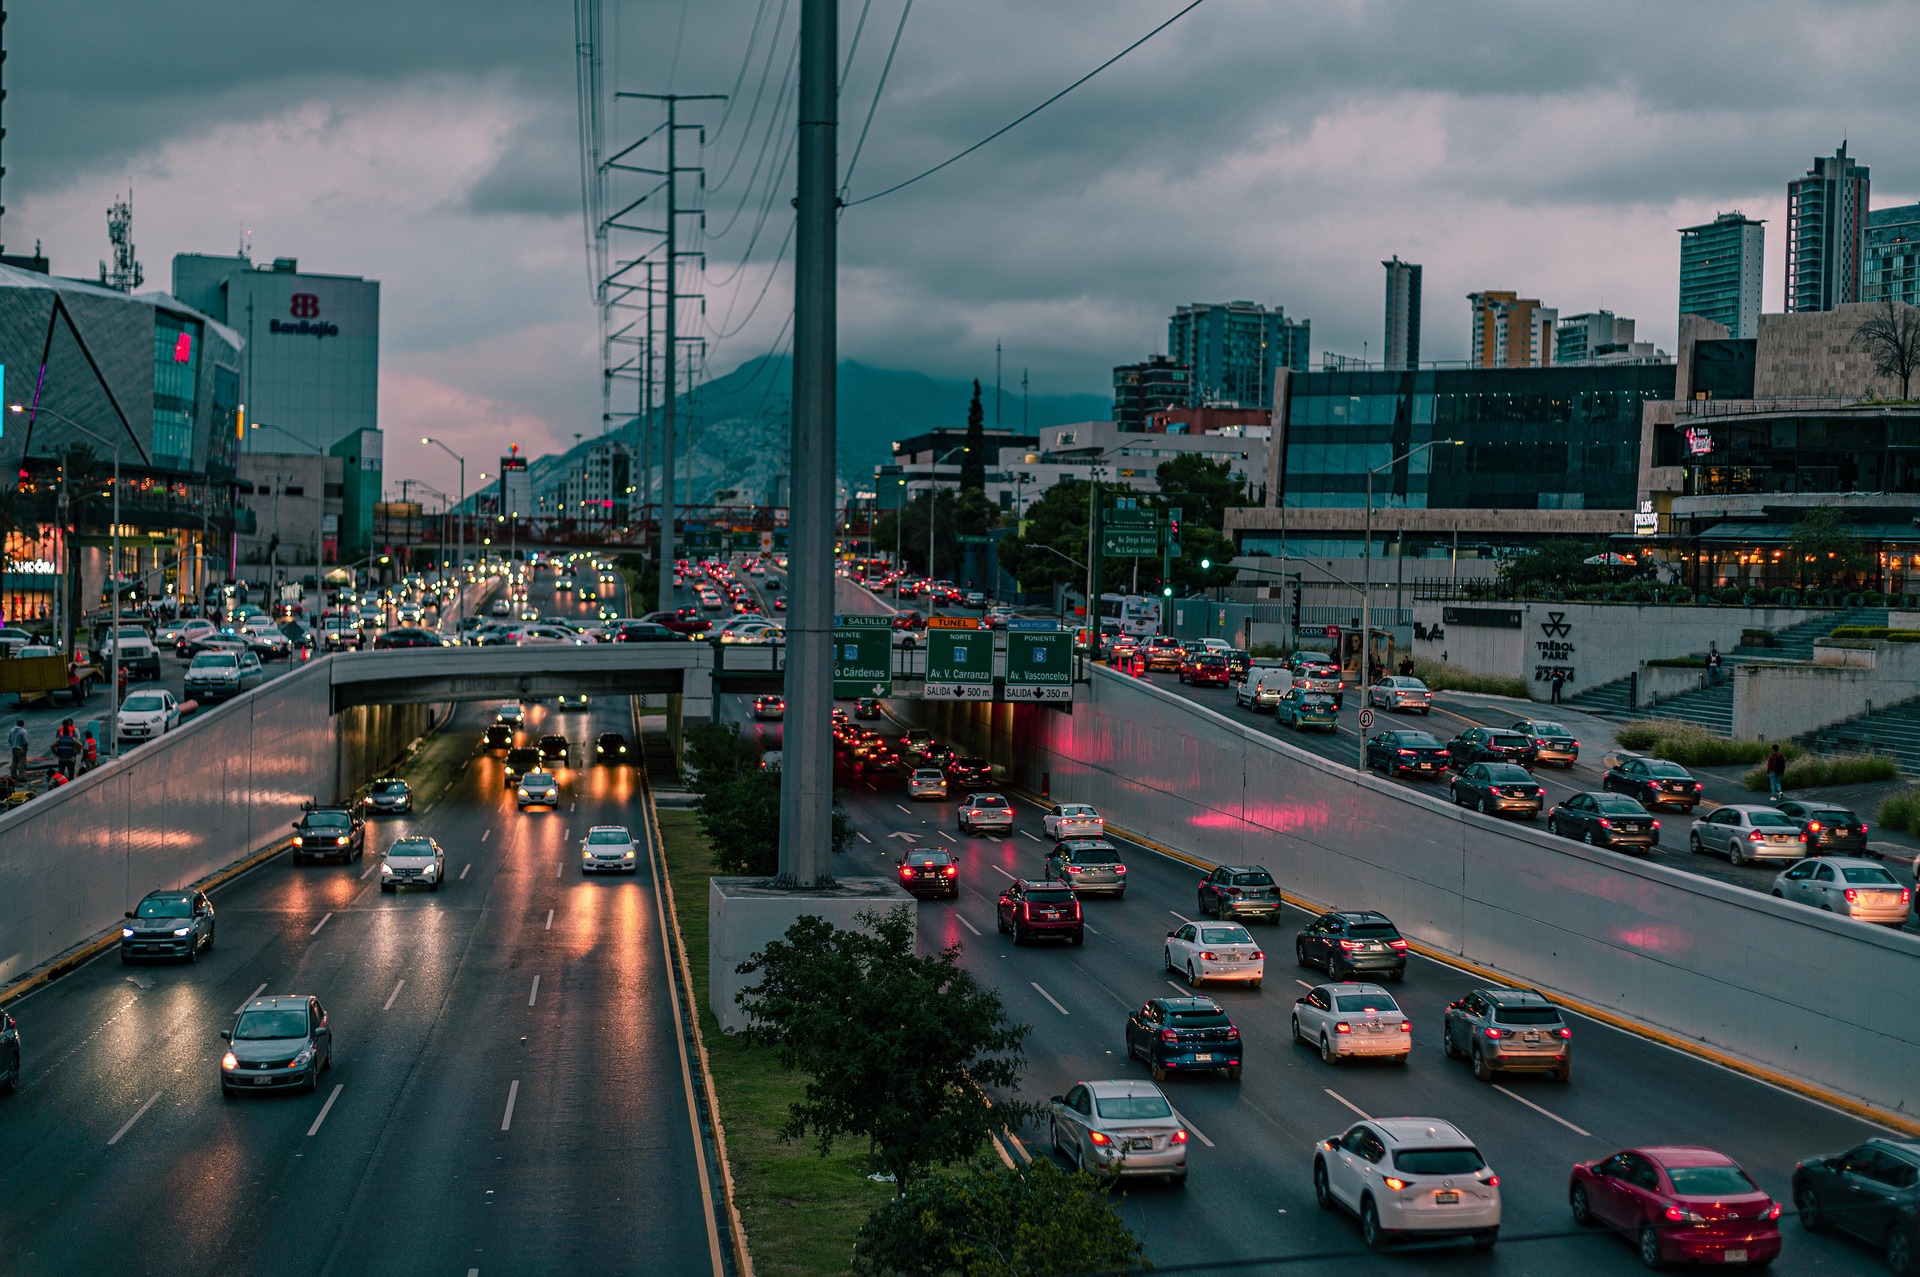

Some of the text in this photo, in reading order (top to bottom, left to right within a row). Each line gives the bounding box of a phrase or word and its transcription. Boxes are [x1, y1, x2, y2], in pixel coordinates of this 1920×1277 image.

[1641, 500, 1652, 513] LOS
[1125, 536, 1139, 545] Diego
[1140, 536, 1156, 544] Rivera
[848, 617, 888, 625] SALTILLO
[938, 619, 969, 627] TUNEL
[955, 652, 965, 661] 11
[1036, 651, 1043, 661] 8
[1542, 651, 1568, 660] PARK
[843, 666, 885, 678] Cárdenas
[930, 668, 989, 679] Av. V. Carranza
[1009, 670, 1069, 681] Av. Vasconcelos
[927, 687, 951, 696] SALIDA
[967, 688, 980, 696] 500
[1006, 688, 1032, 697] SALIDA
[1046, 689, 1060, 698] 350
